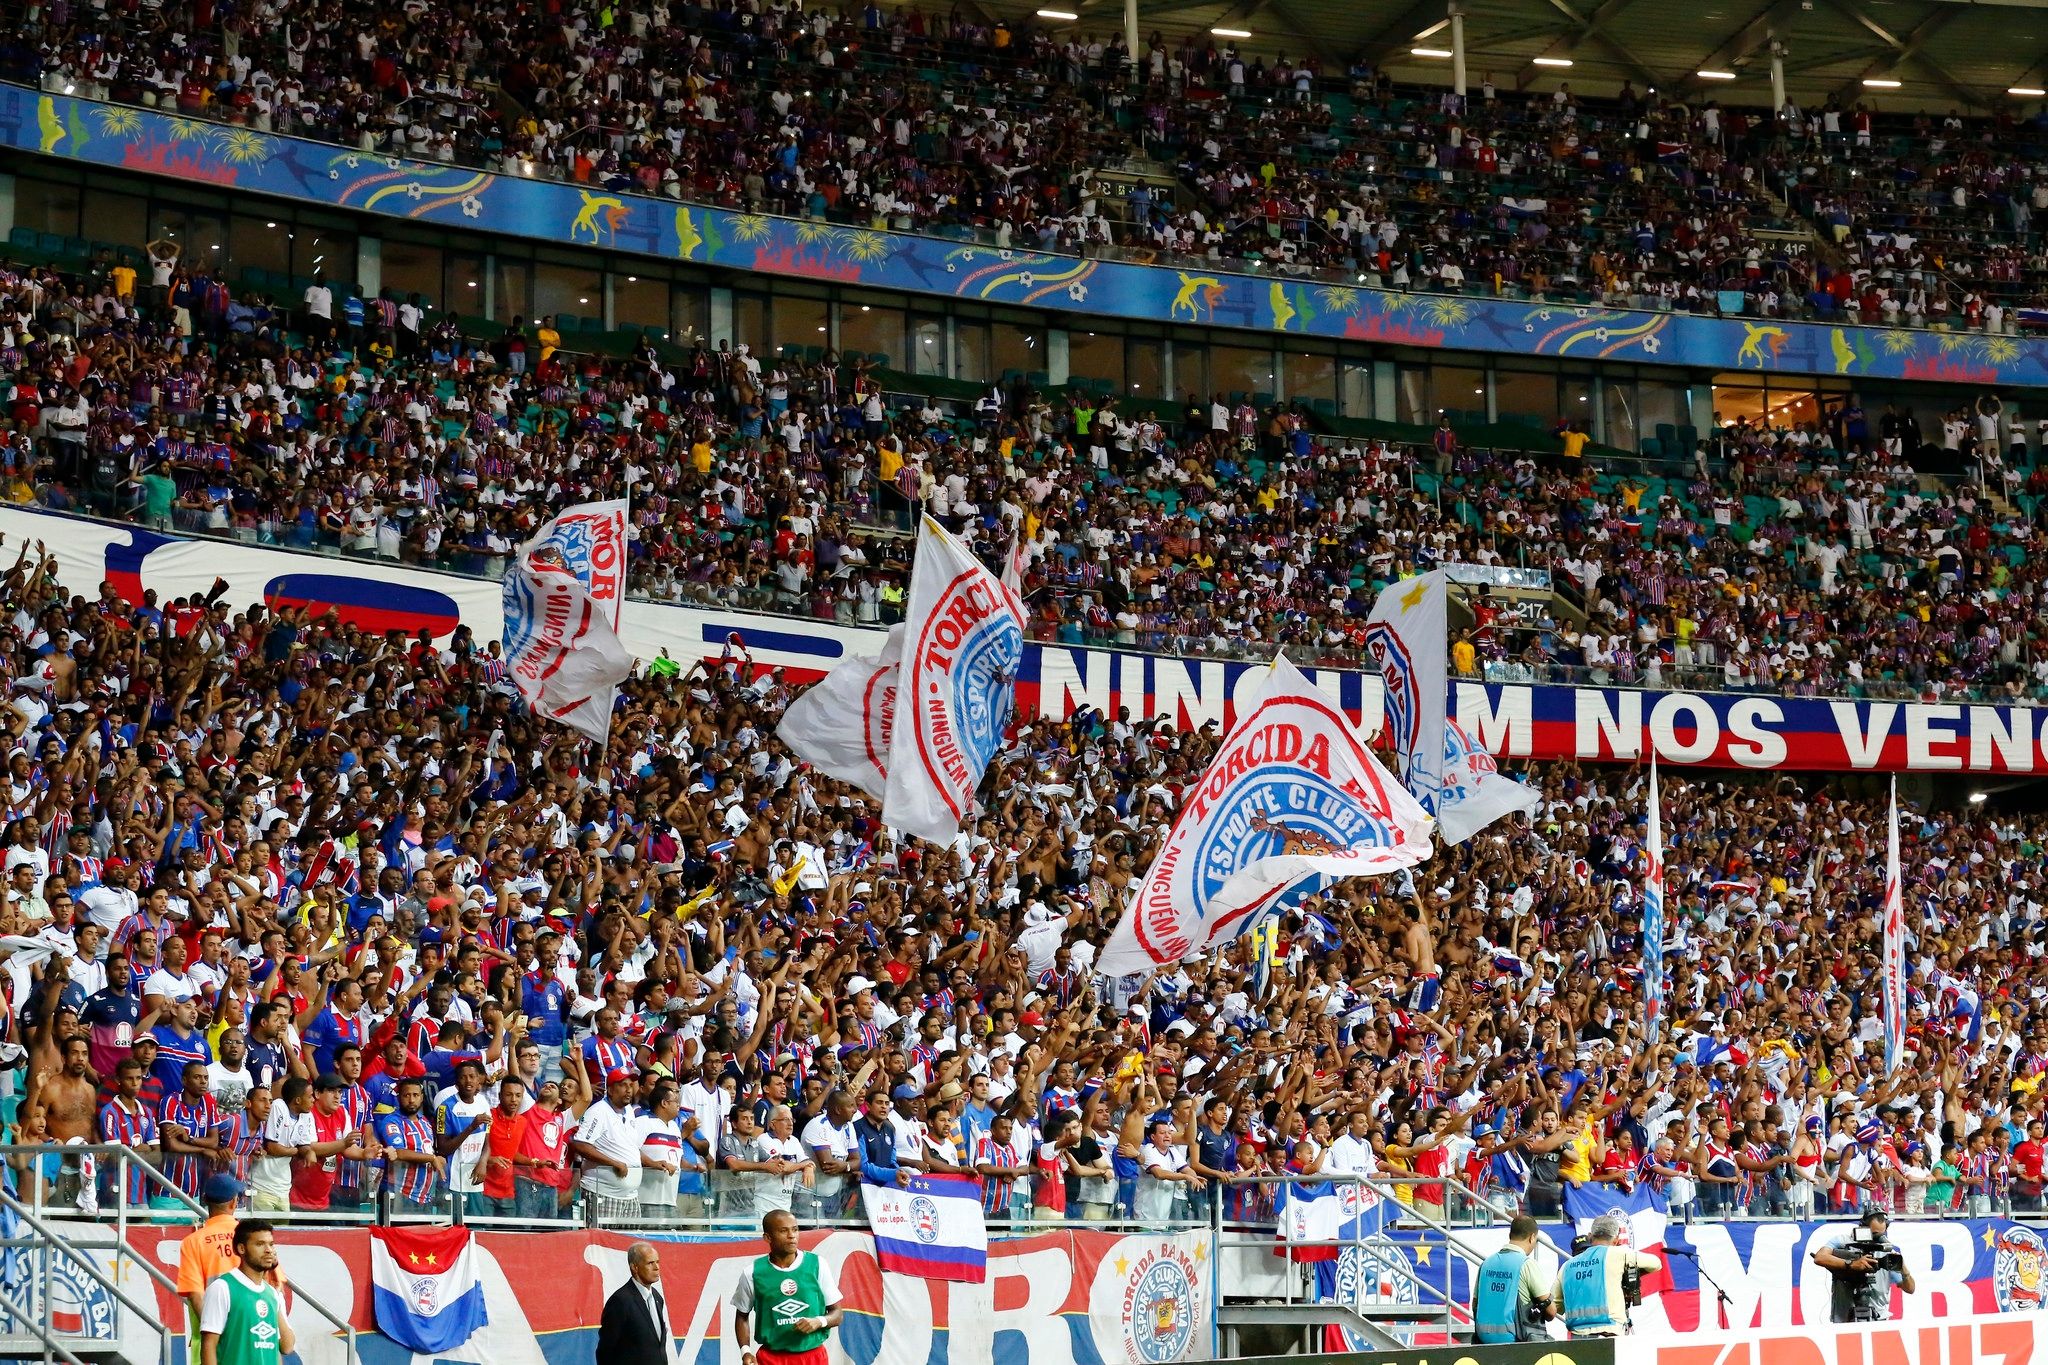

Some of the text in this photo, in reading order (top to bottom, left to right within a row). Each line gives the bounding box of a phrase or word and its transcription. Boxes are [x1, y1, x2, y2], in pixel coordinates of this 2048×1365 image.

[1517, 602, 1544, 619] 217
[1576, 689, 1788, 768] NOS
[1829, 701, 2048, 772] VEN
[1189, 723, 1333, 825] TORCIDA
[1207, 784, 1283, 883] ESPORTE
[1288, 784, 1368, 843] CLUBE
[217, 1244, 233, 1258] 16
[1569, 1257, 1600, 1268] IMPRENSA
[1486, 1269, 1513, 1280] IMPRENSA
[1122, 1243, 1199, 1325] TORCIDA BAMOR
[1490, 1281, 1506, 1293] 069
[1138, 1275, 1156, 1341] ESPORTE
[1155, 1267, 1181, 1288] CLUBE
[777, 1315, 804, 1324] umbr
[254, 1341, 275, 1350] umbro
